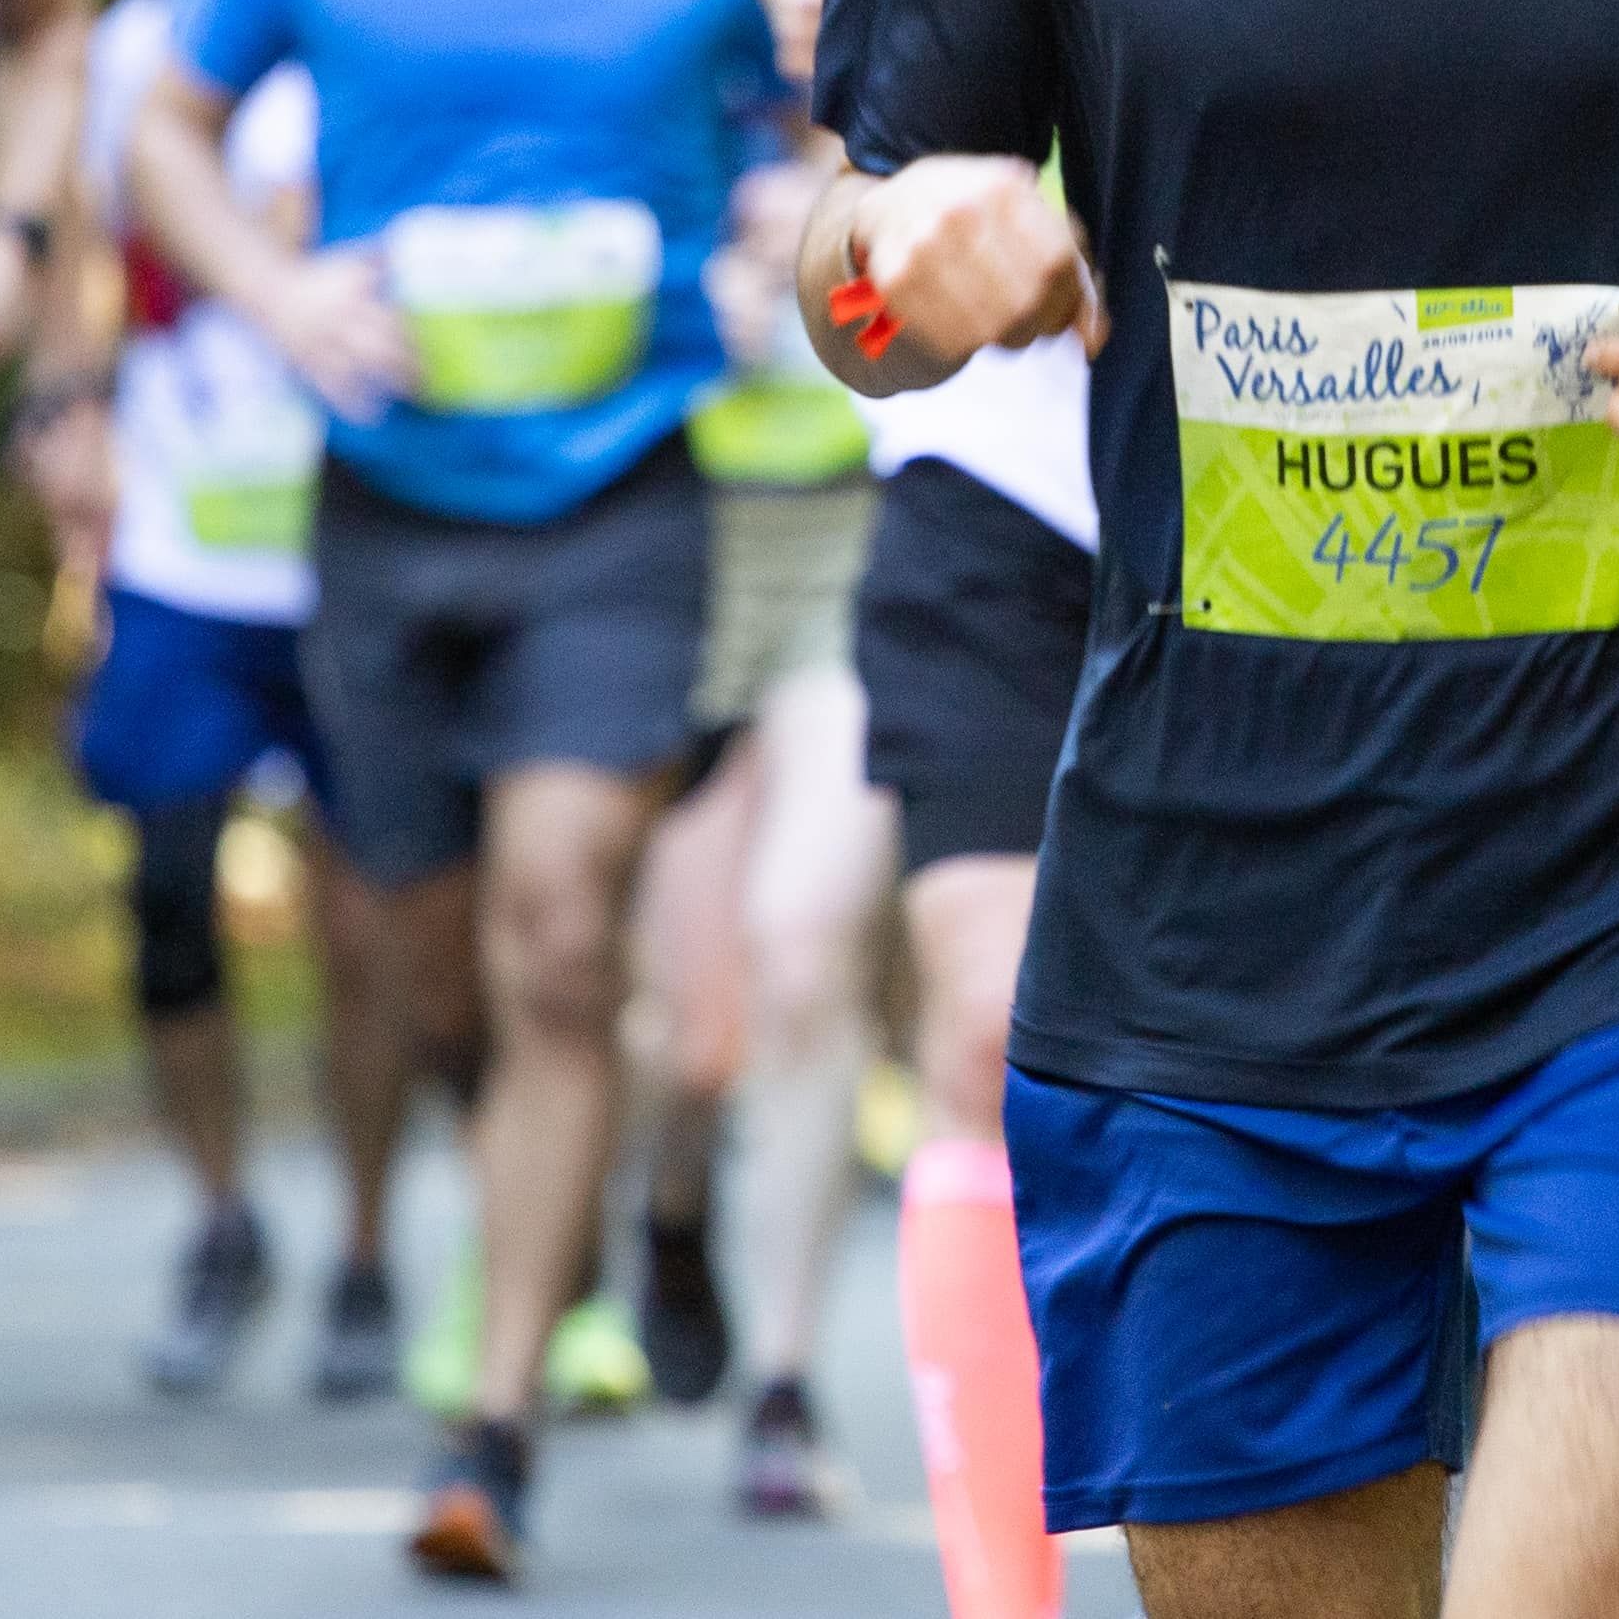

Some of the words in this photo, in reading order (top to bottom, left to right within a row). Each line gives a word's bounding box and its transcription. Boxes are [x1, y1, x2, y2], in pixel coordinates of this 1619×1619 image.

[1194, 298, 1319, 356] Paris
[1276, 436, 1538, 493] HUGUES
[1312, 512, 1508, 595] 4457
